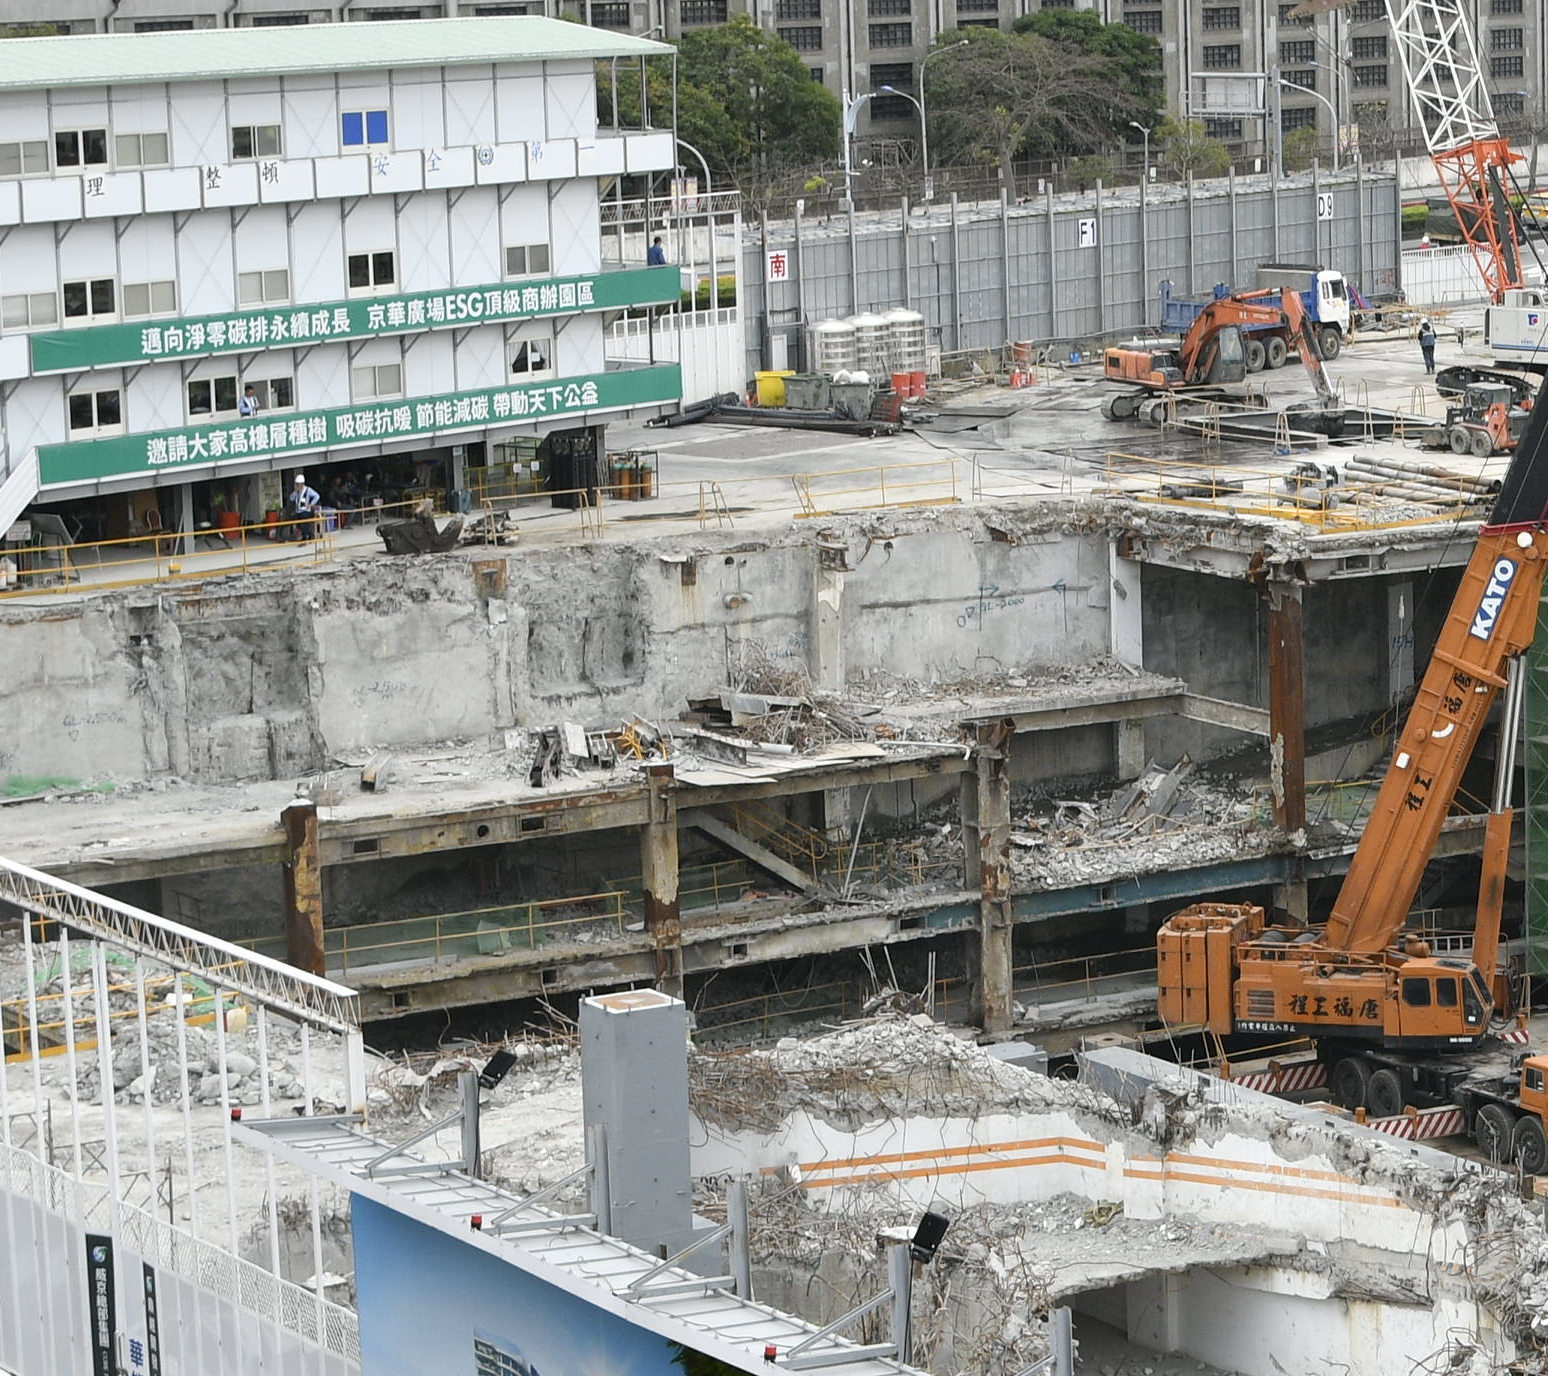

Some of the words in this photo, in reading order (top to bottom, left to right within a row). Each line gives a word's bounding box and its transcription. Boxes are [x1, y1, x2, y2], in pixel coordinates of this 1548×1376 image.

[1318, 195, 1333, 217] D9
[1080, 220, 1095, 245] F1
[768, 253, 786, 278] 南
[141, 307, 351, 355] 邁向淨零碳排永續成長
[367, 280, 595, 330] 京華廣場ESG頂級商辦園區
[147, 417, 327, 465] 邀請大家高樓層種樹
[336, 406, 412, 439] 吸碳抗暖
[416, 395, 489, 428] 節能減碳
[493, 381, 599, 417] 帶動天下公益
[1470, 558, 1514, 639] KATO
